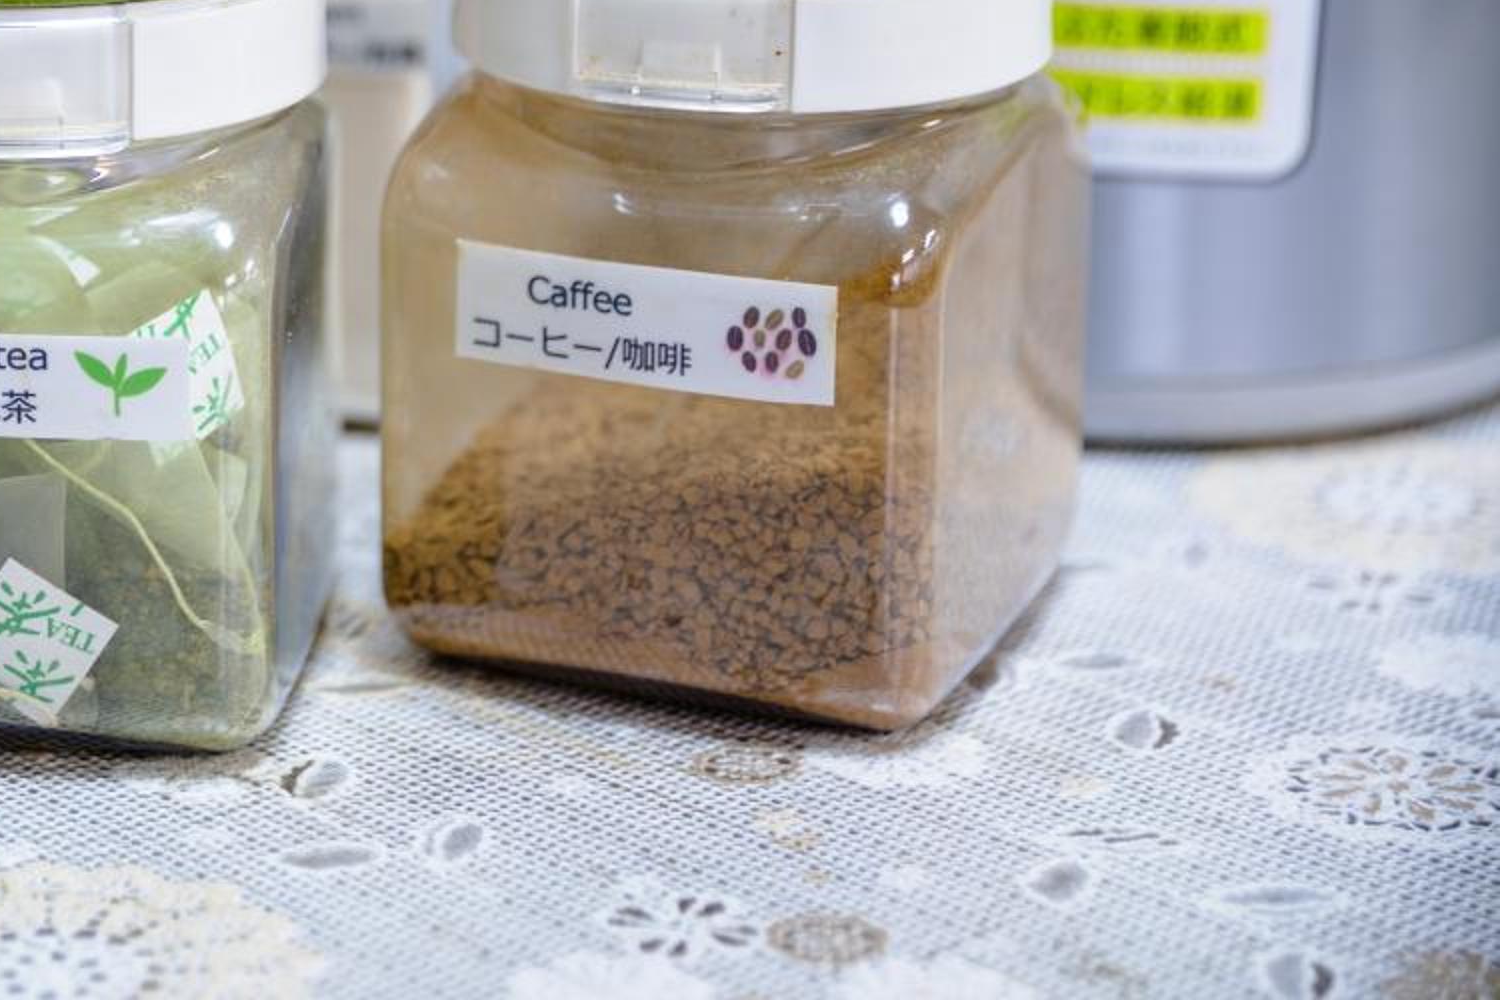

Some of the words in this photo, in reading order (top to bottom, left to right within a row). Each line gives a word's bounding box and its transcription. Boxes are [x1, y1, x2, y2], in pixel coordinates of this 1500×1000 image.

[526, 274, 634, 317] Caffee
[472, 315, 693, 376] コーヒー/咖啡
[47, 617, 96, 654] TEA
